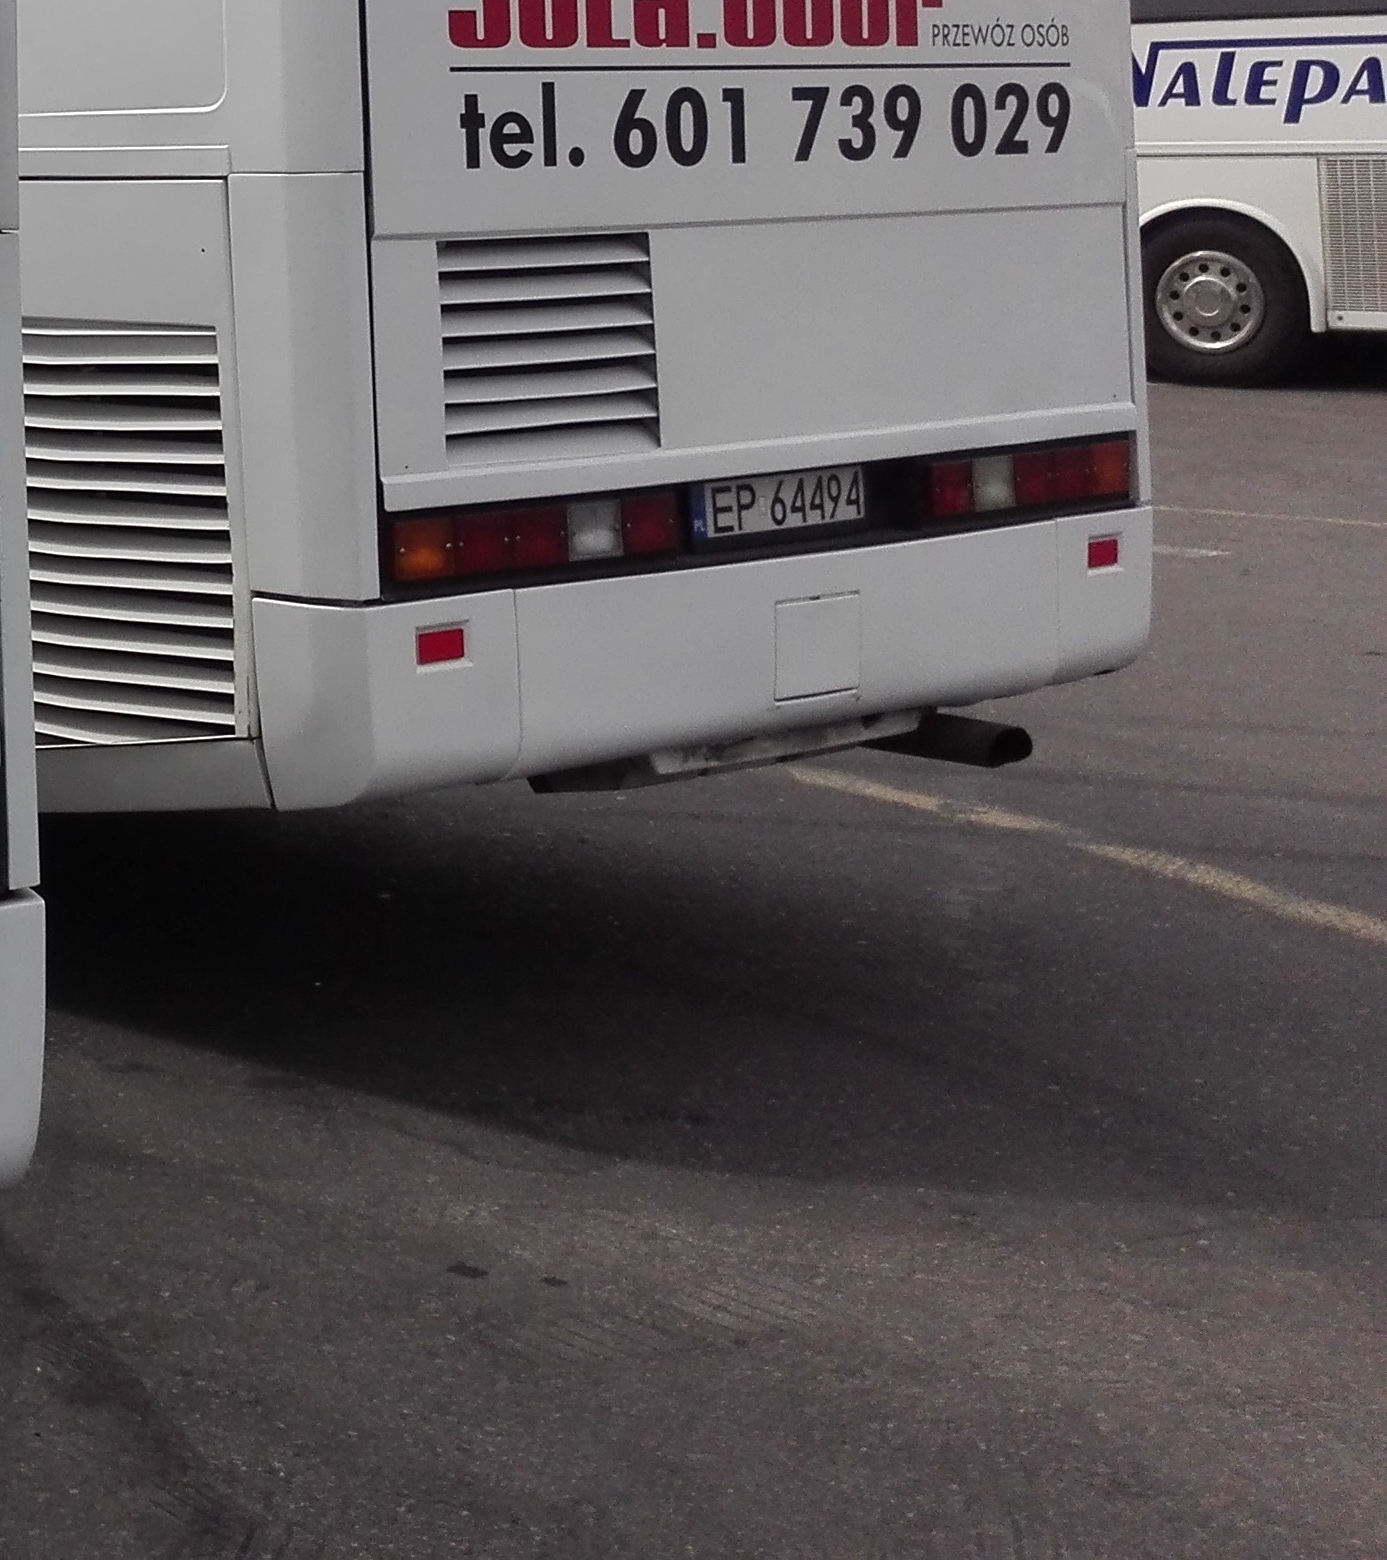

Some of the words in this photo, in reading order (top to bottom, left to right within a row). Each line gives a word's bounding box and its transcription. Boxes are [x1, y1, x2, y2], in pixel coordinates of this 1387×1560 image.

[931, 17, 1015, 48] PRZEWÓZ
[1021, 18, 1071, 48] OSÓB
[459, 81, 586, 170] tel.
[612, 86, 748, 168] 601
[790, 84, 923, 163] 739
[950, 82, 1072, 159] 029
[710, 483, 756, 535] EP
[770, 468, 863, 527] 64494
